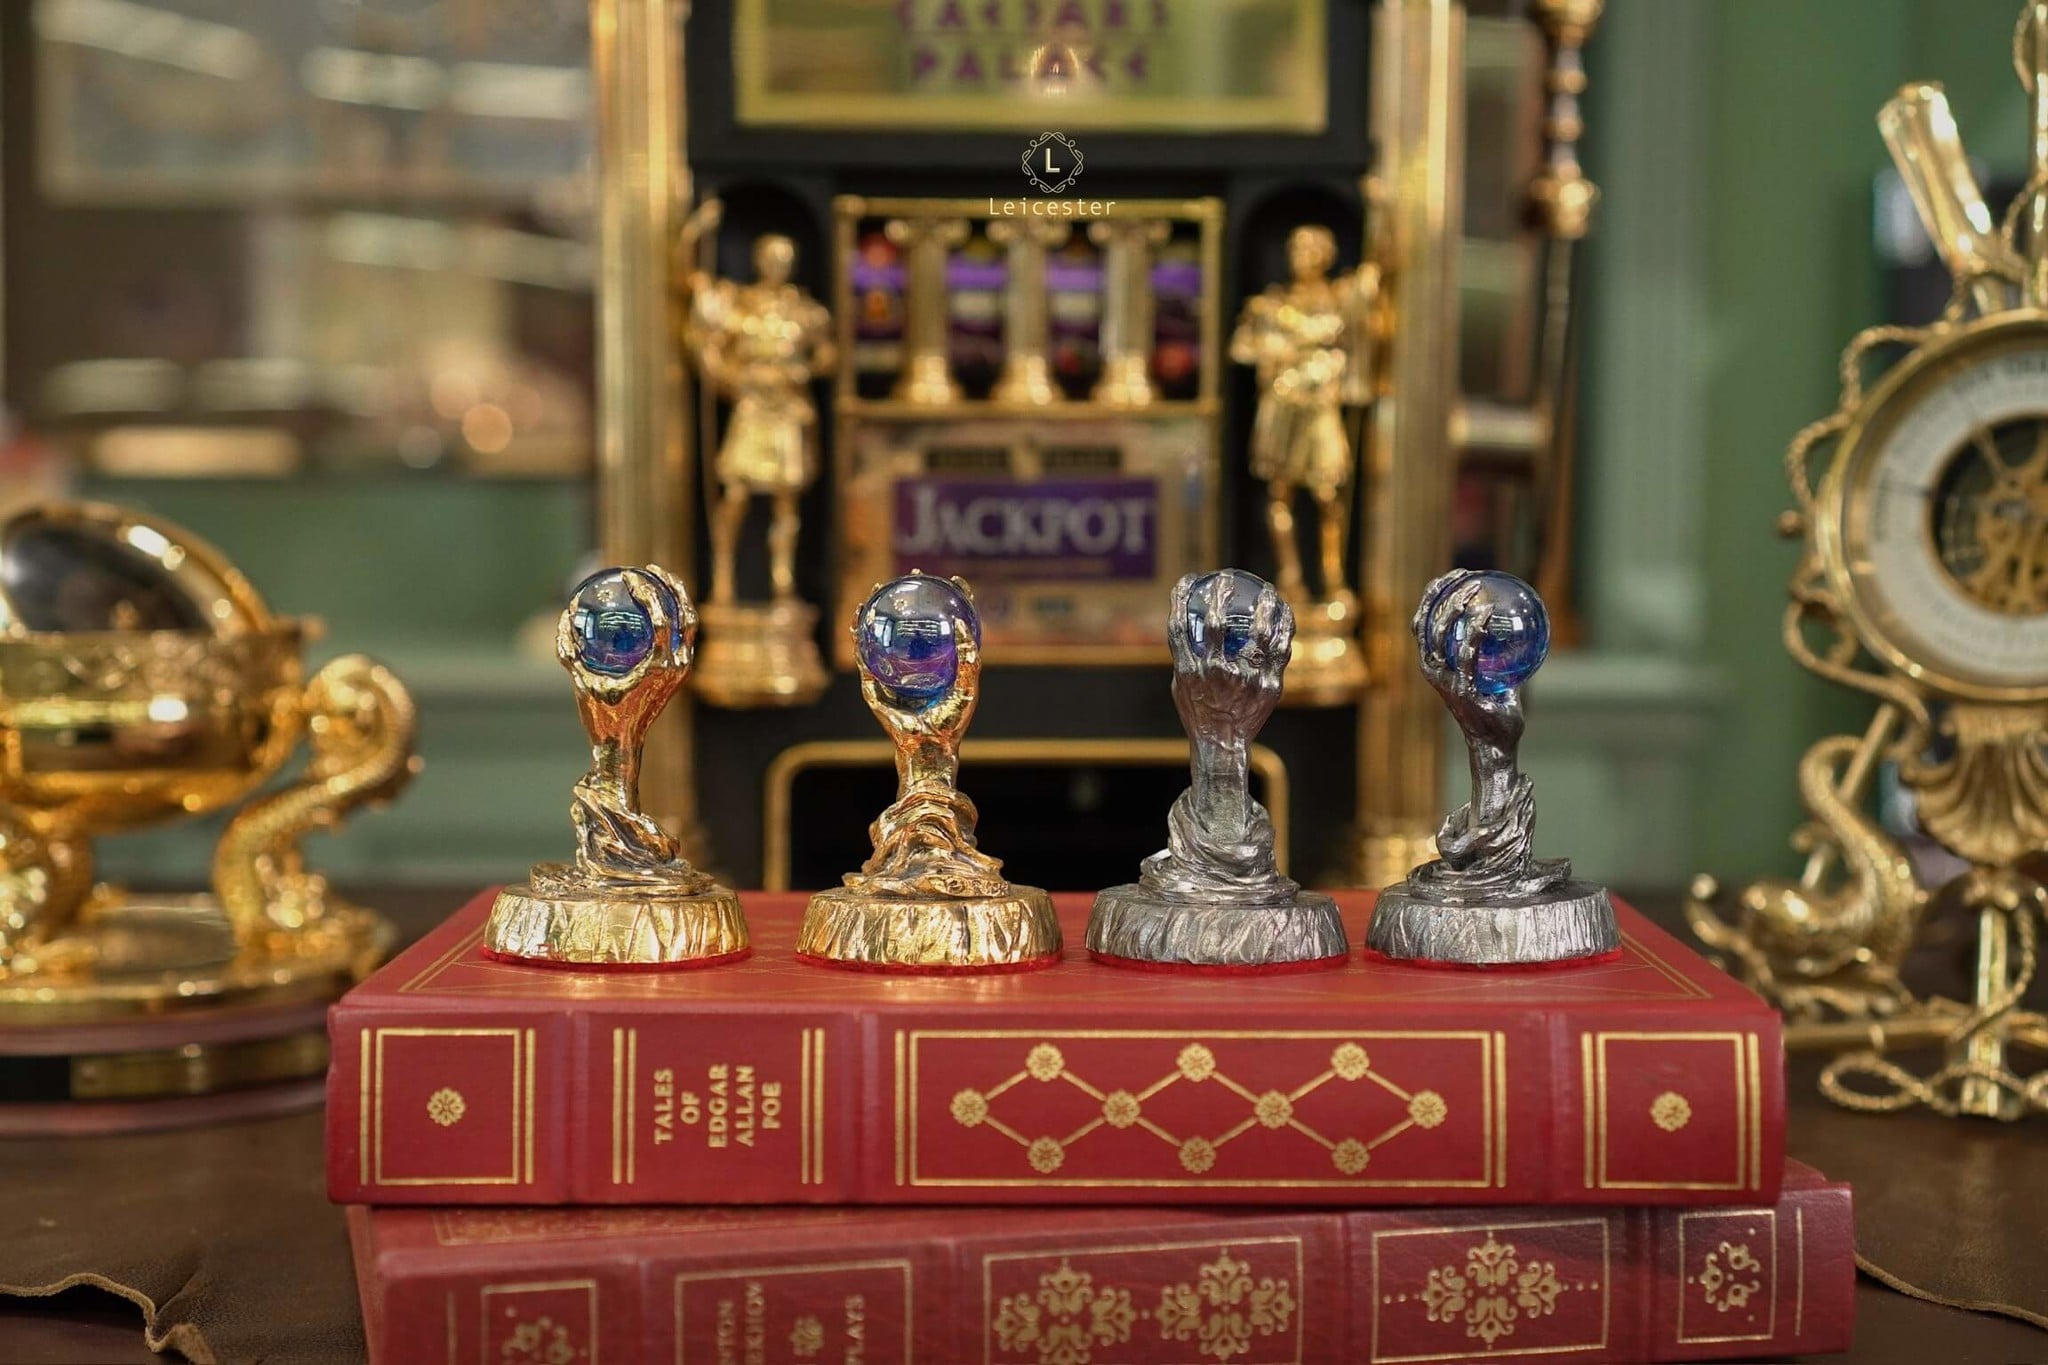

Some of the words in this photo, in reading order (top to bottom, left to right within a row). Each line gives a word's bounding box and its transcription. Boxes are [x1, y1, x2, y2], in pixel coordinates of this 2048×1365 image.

[653, 1068, 674, 1145] TALES
[680, 1091, 700, 1125] OF
[708, 1063, 729, 1148] EDGAR
[735, 1065, 755, 1147] ALLAN
[761, 1081, 781, 1129] POE
